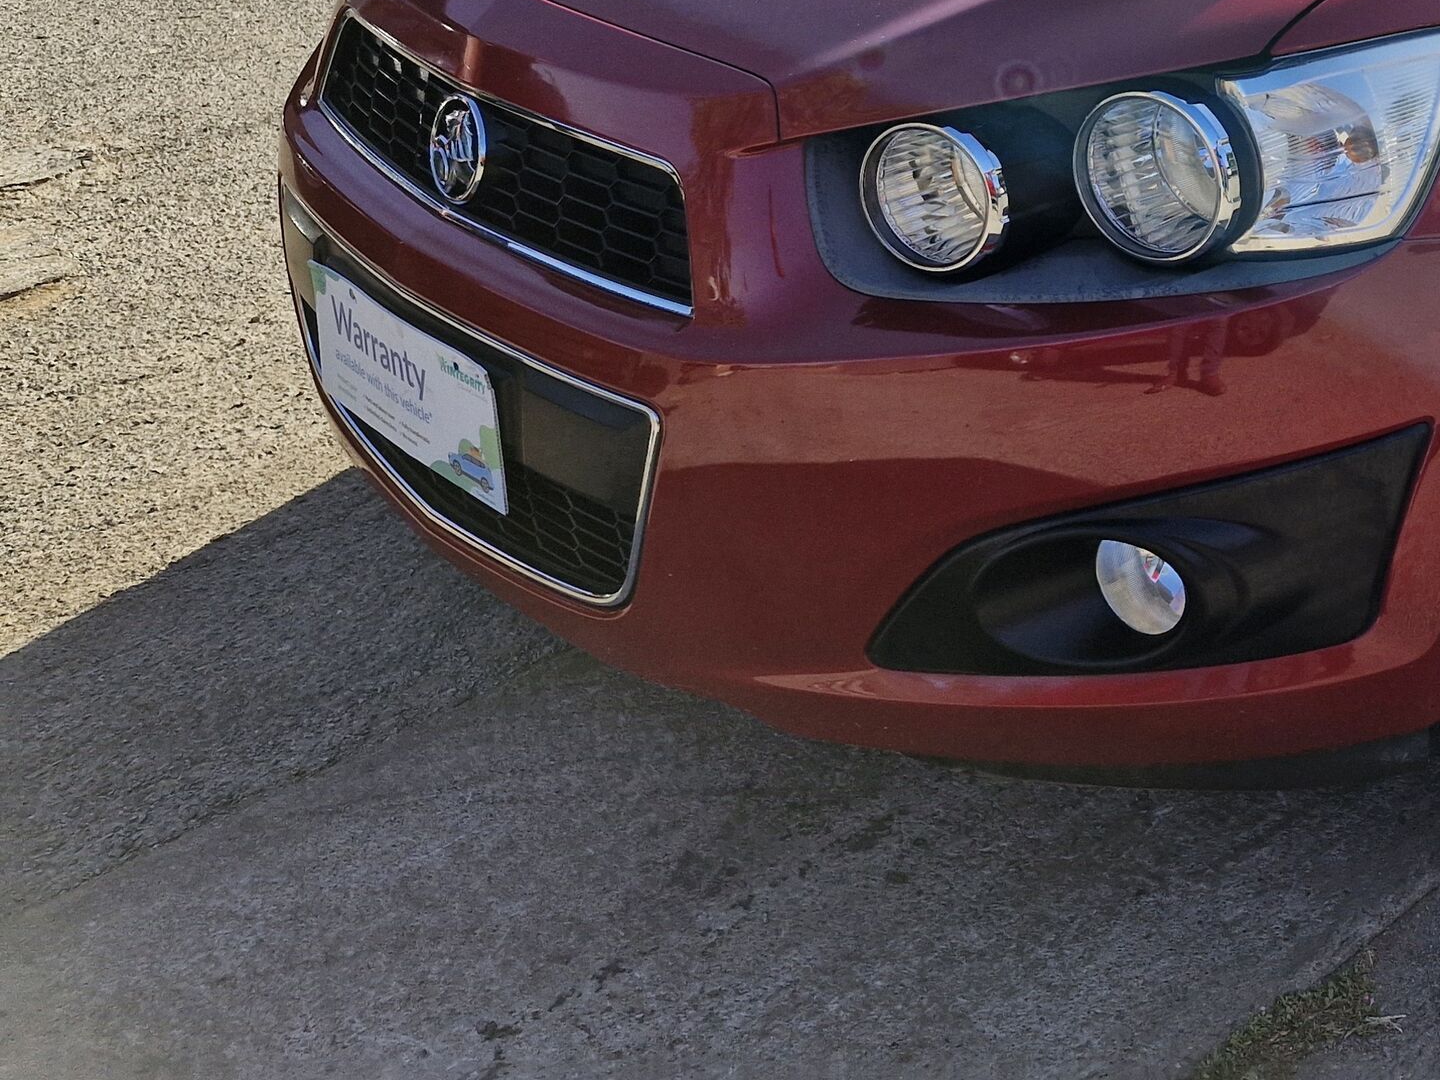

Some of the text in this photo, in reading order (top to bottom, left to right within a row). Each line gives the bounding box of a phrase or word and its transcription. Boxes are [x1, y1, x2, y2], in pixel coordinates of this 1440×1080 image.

[331, 295, 426, 400] Warranty
[367, 372, 384, 393] with
[384, 383, 400, 404] this
